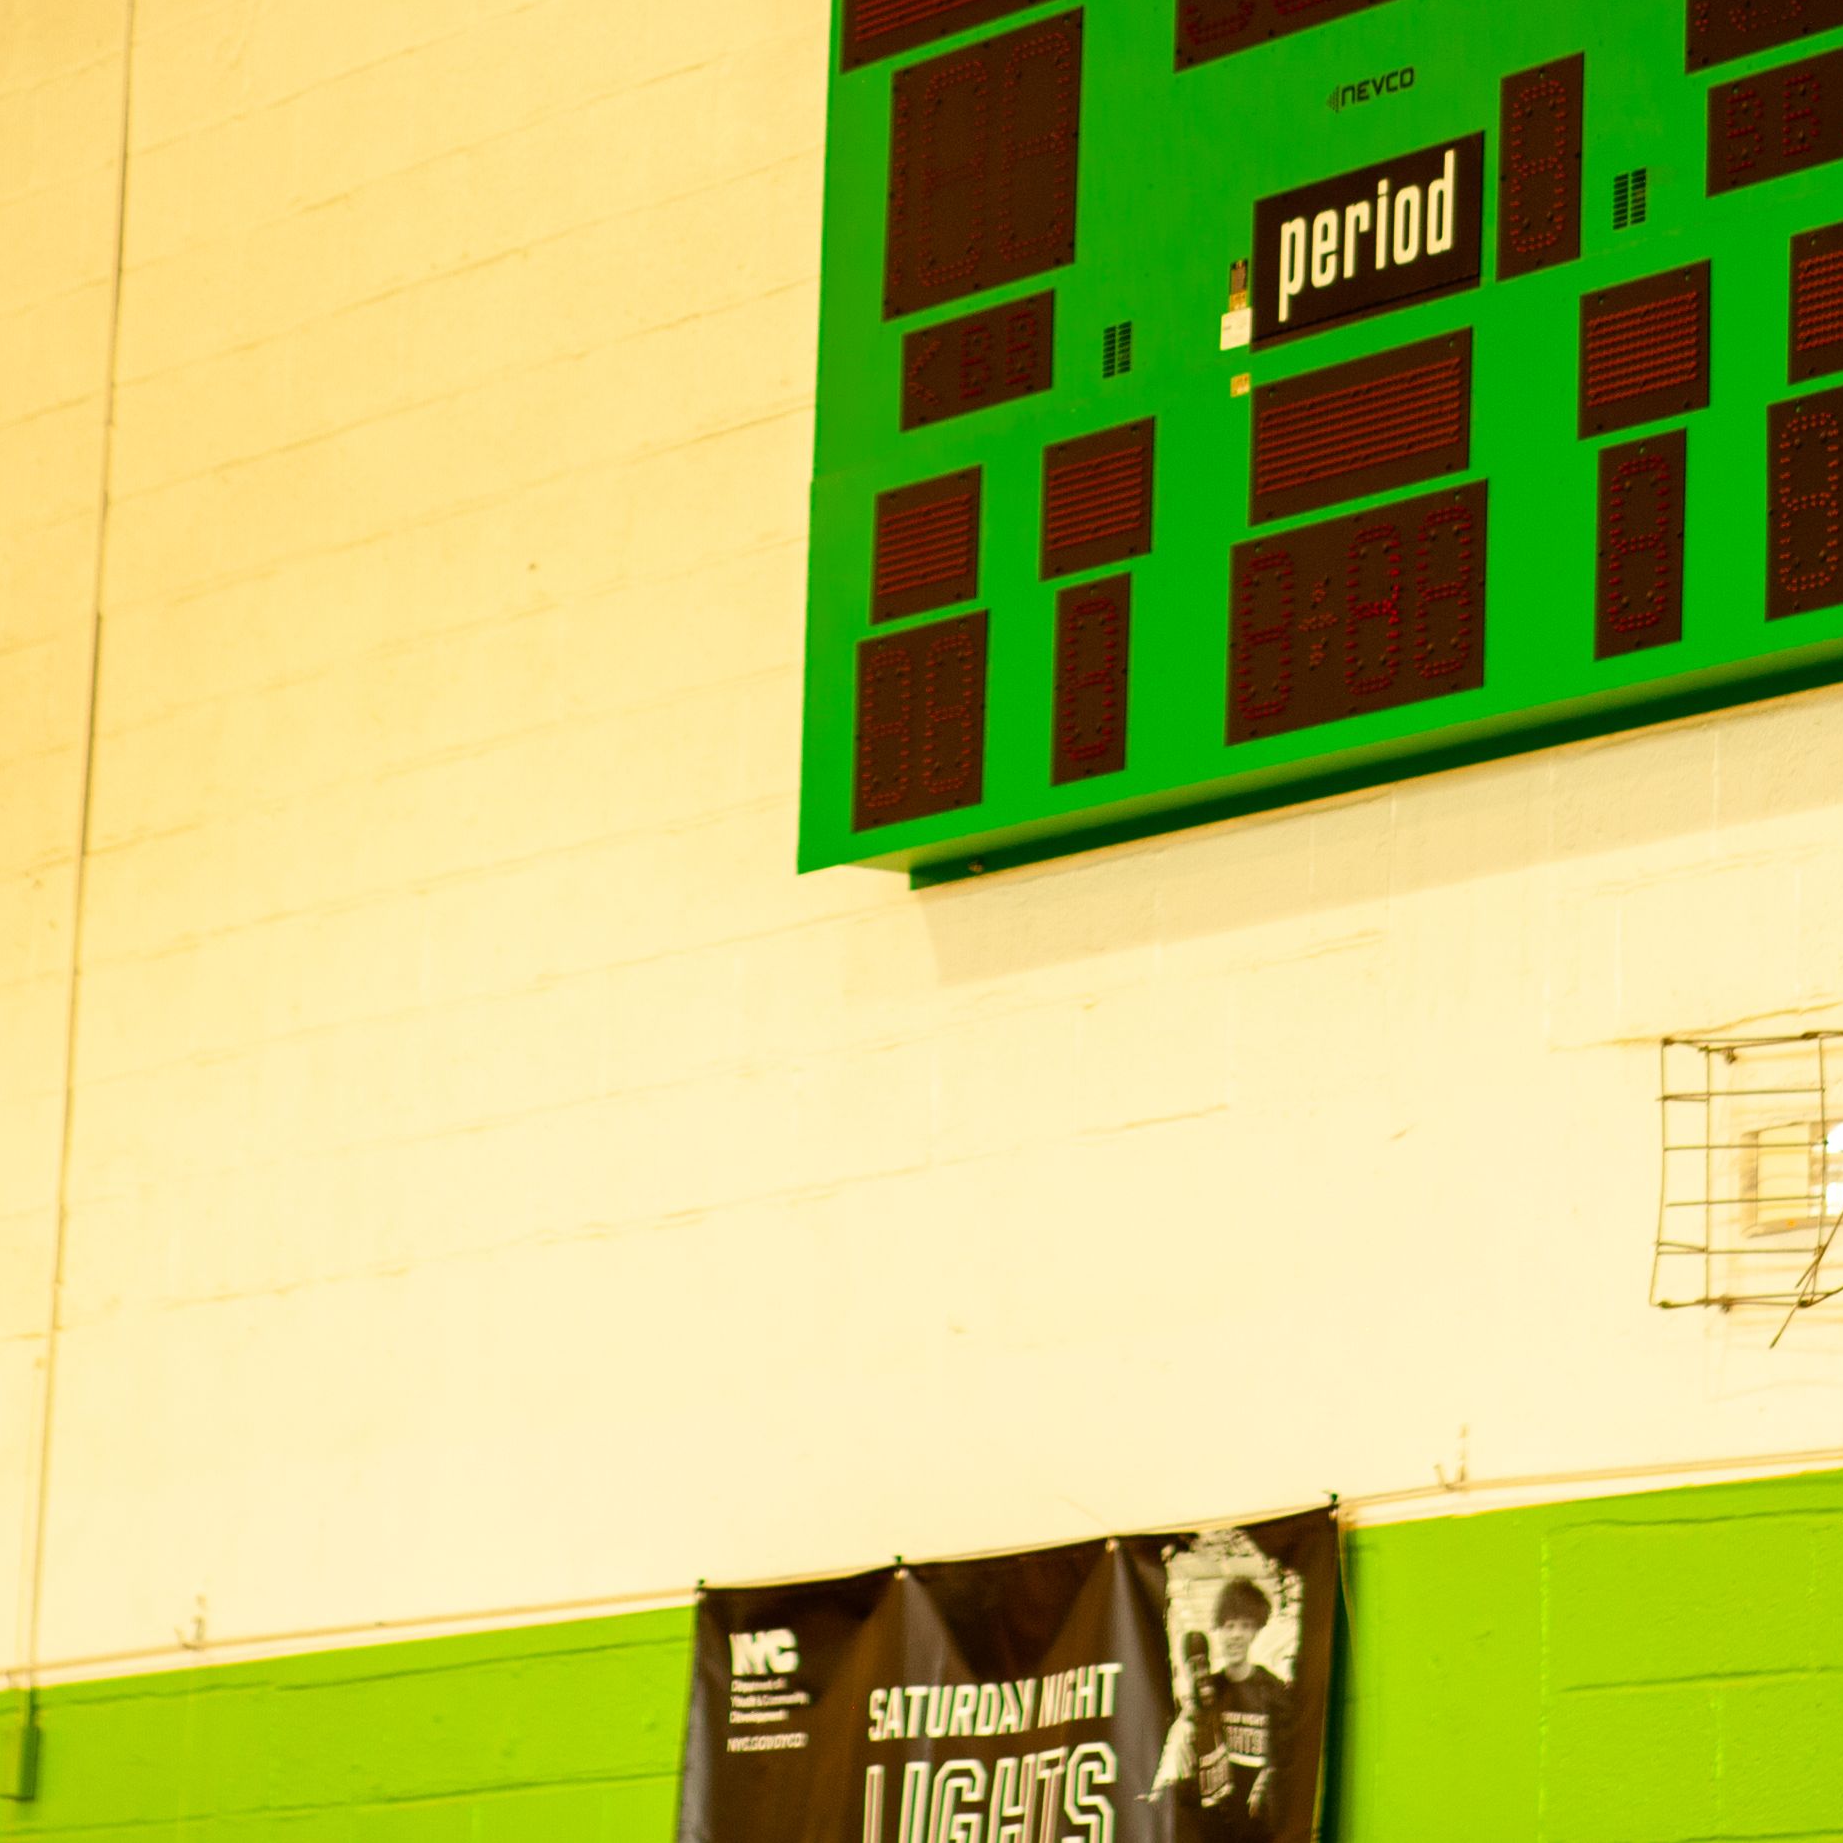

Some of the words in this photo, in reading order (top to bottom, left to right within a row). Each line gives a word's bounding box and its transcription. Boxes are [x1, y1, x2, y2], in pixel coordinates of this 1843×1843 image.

[1278, 148, 1456, 324] period
[729, 1629, 799, 1676] NYC
[868, 1677, 1037, 1742] SATURDAY
[1037, 1662, 1124, 1729] NIGHT
